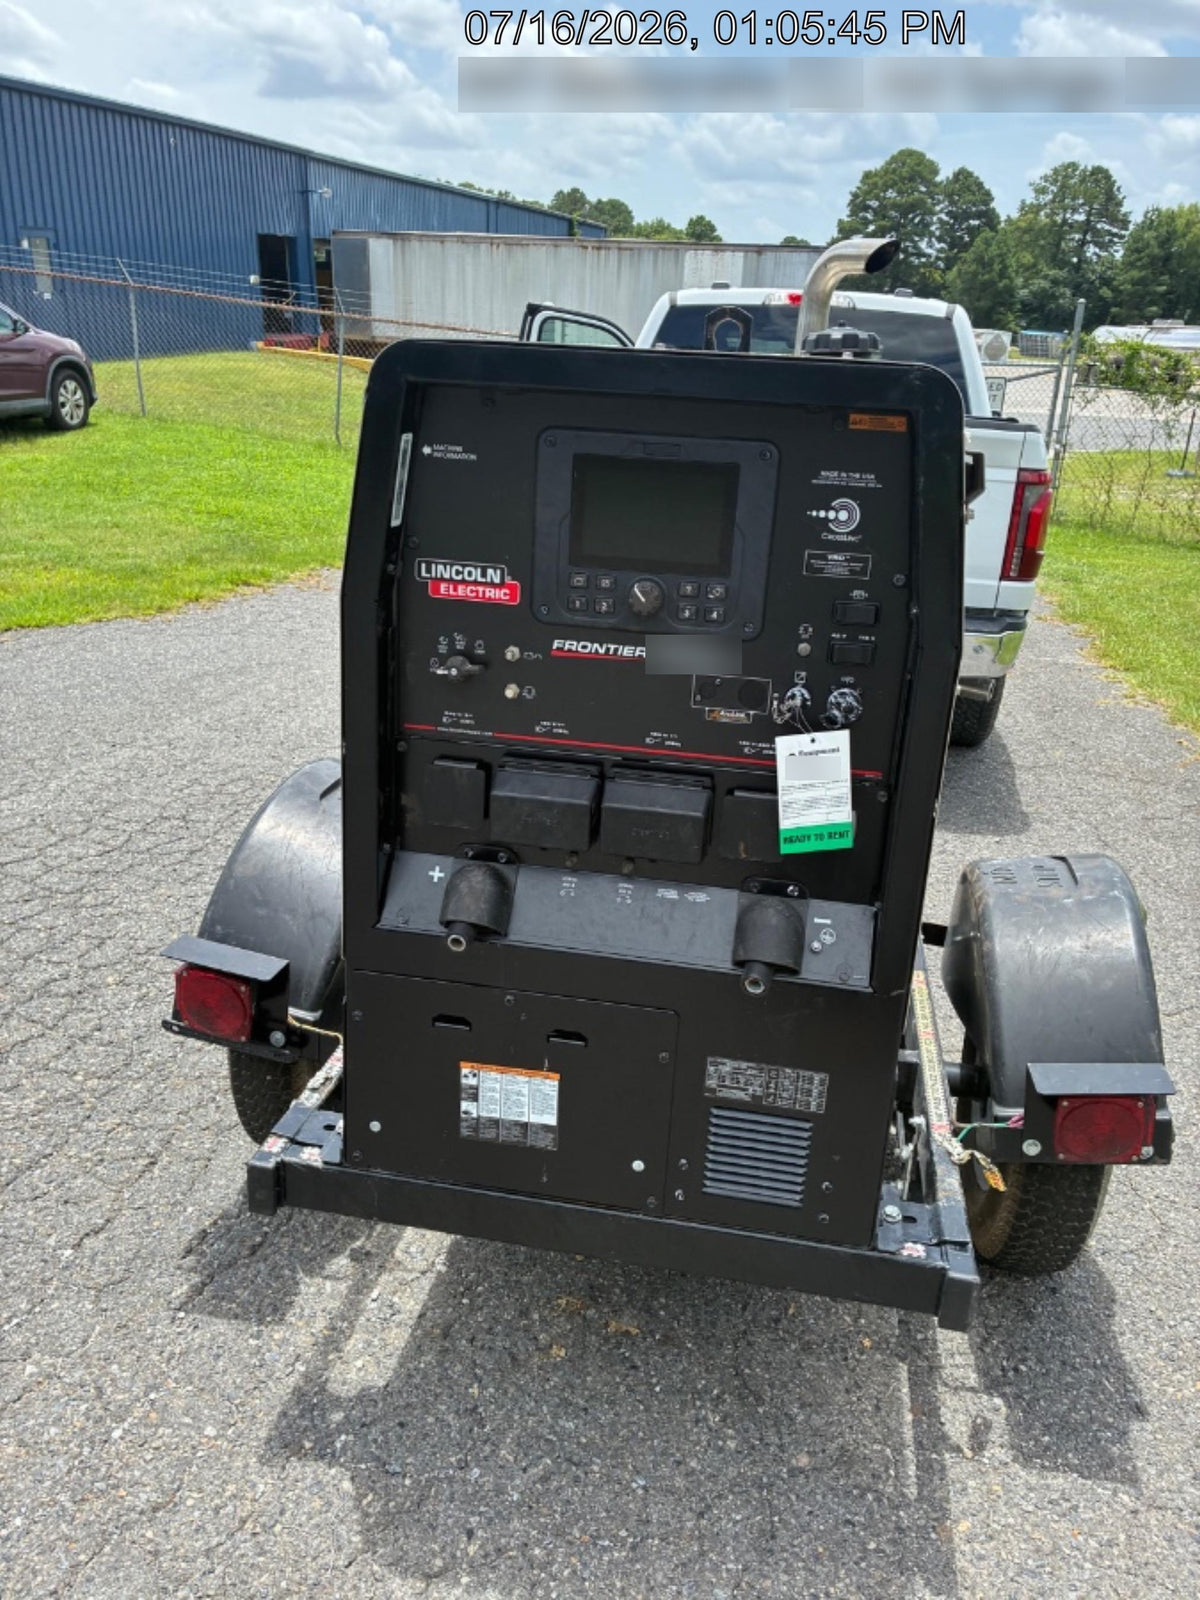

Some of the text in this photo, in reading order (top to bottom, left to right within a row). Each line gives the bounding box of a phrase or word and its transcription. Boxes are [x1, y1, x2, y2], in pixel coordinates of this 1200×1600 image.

[421, 562, 501, 584] LINCOLN
[439, 583, 511, 600] ELECTRIC
[552, 638, 646, 658] FRONTIER
[783, 829, 851, 845] READY TO RENT
